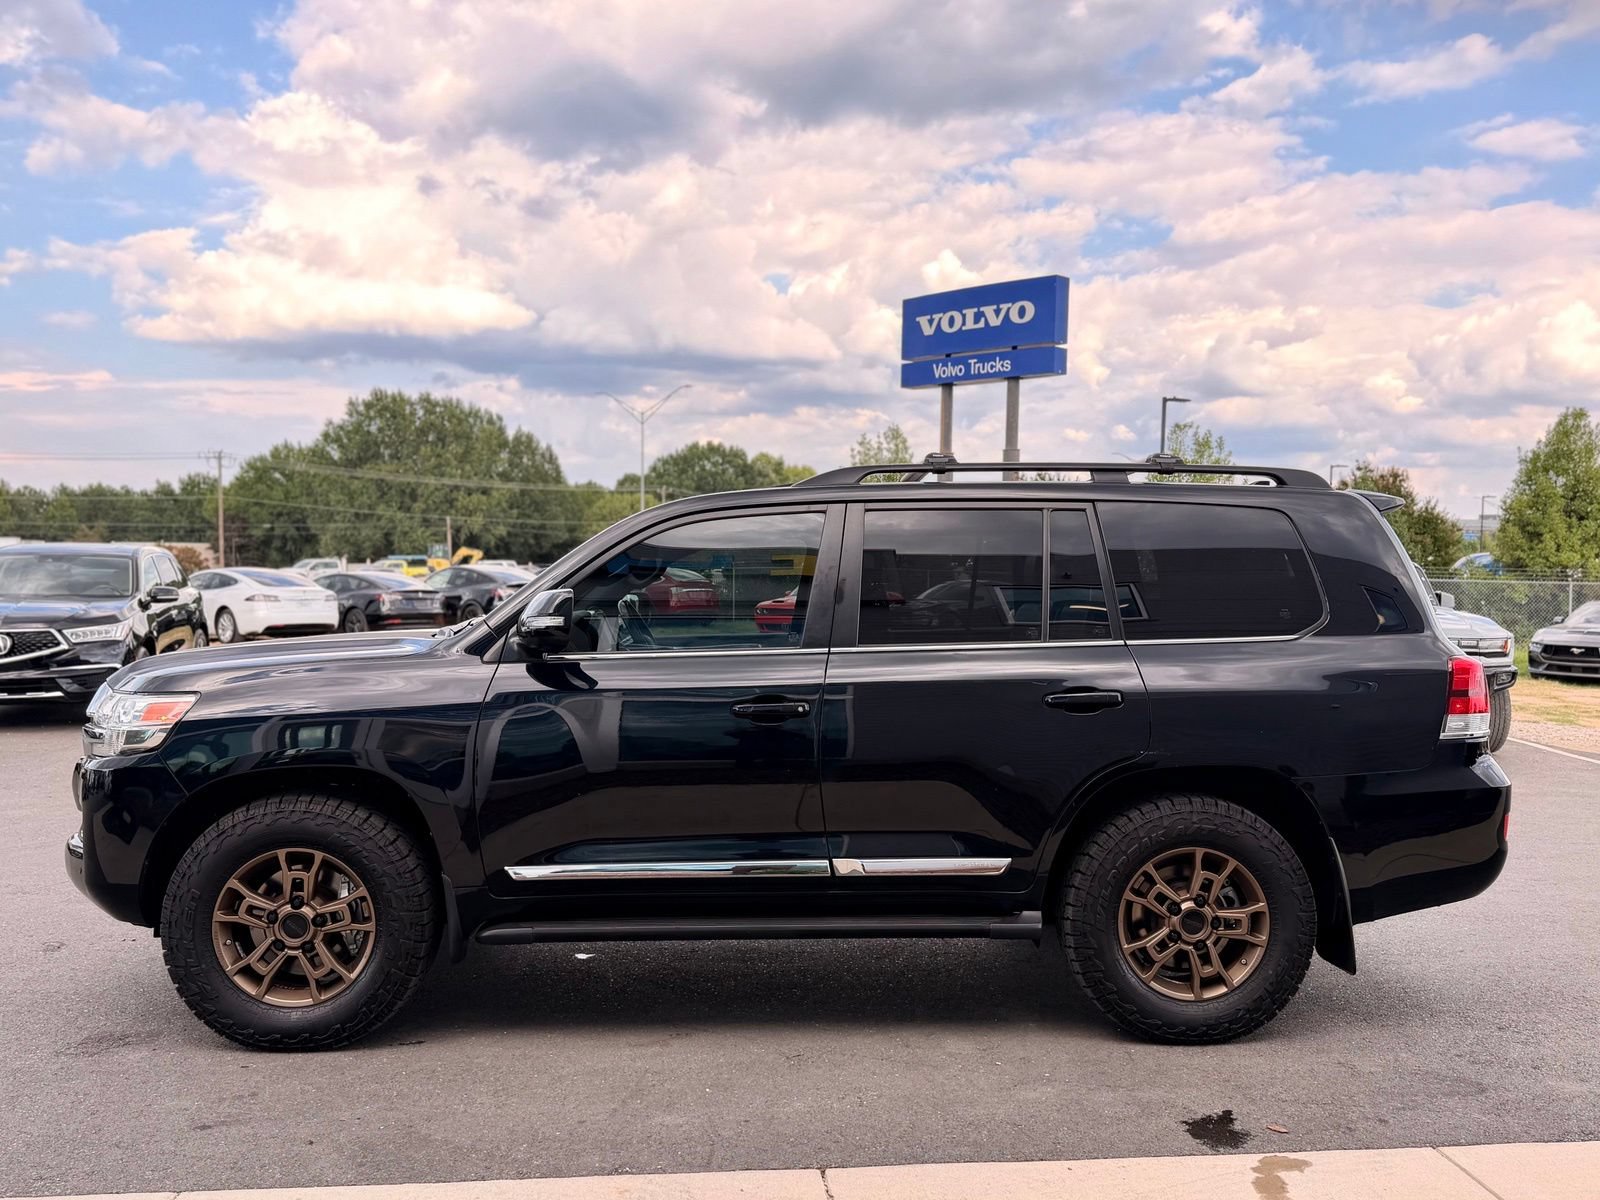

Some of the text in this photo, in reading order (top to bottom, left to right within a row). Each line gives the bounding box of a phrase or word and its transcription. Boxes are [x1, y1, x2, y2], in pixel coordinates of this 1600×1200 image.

[916, 300, 1035, 336] VOLVO
[933, 356, 1011, 378] Volvo Trucks
